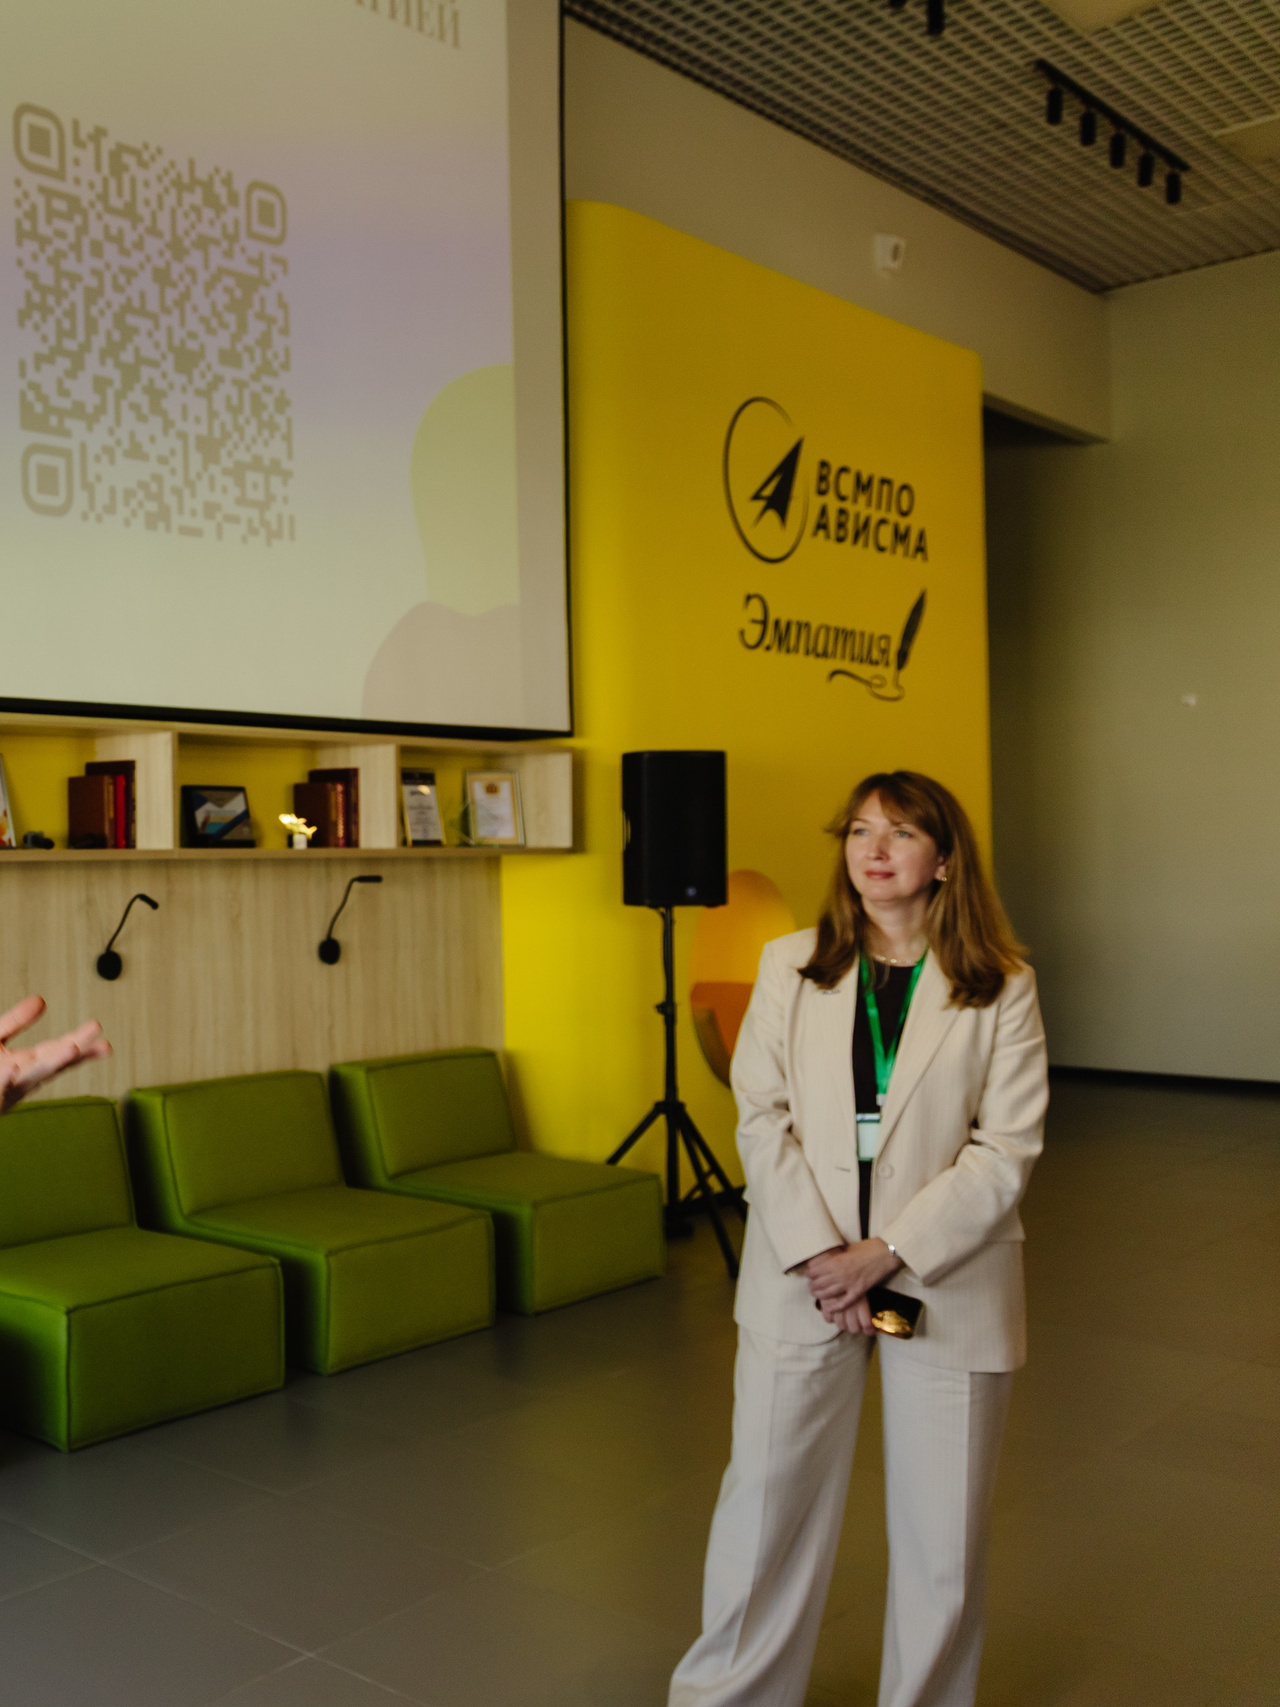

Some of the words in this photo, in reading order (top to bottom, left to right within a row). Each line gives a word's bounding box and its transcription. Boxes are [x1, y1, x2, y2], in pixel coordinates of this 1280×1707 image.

[814, 458, 916, 519] ВСМПО
[811, 502, 930, 562] АВИСМА
[737, 592, 892, 668] Эмпатия
